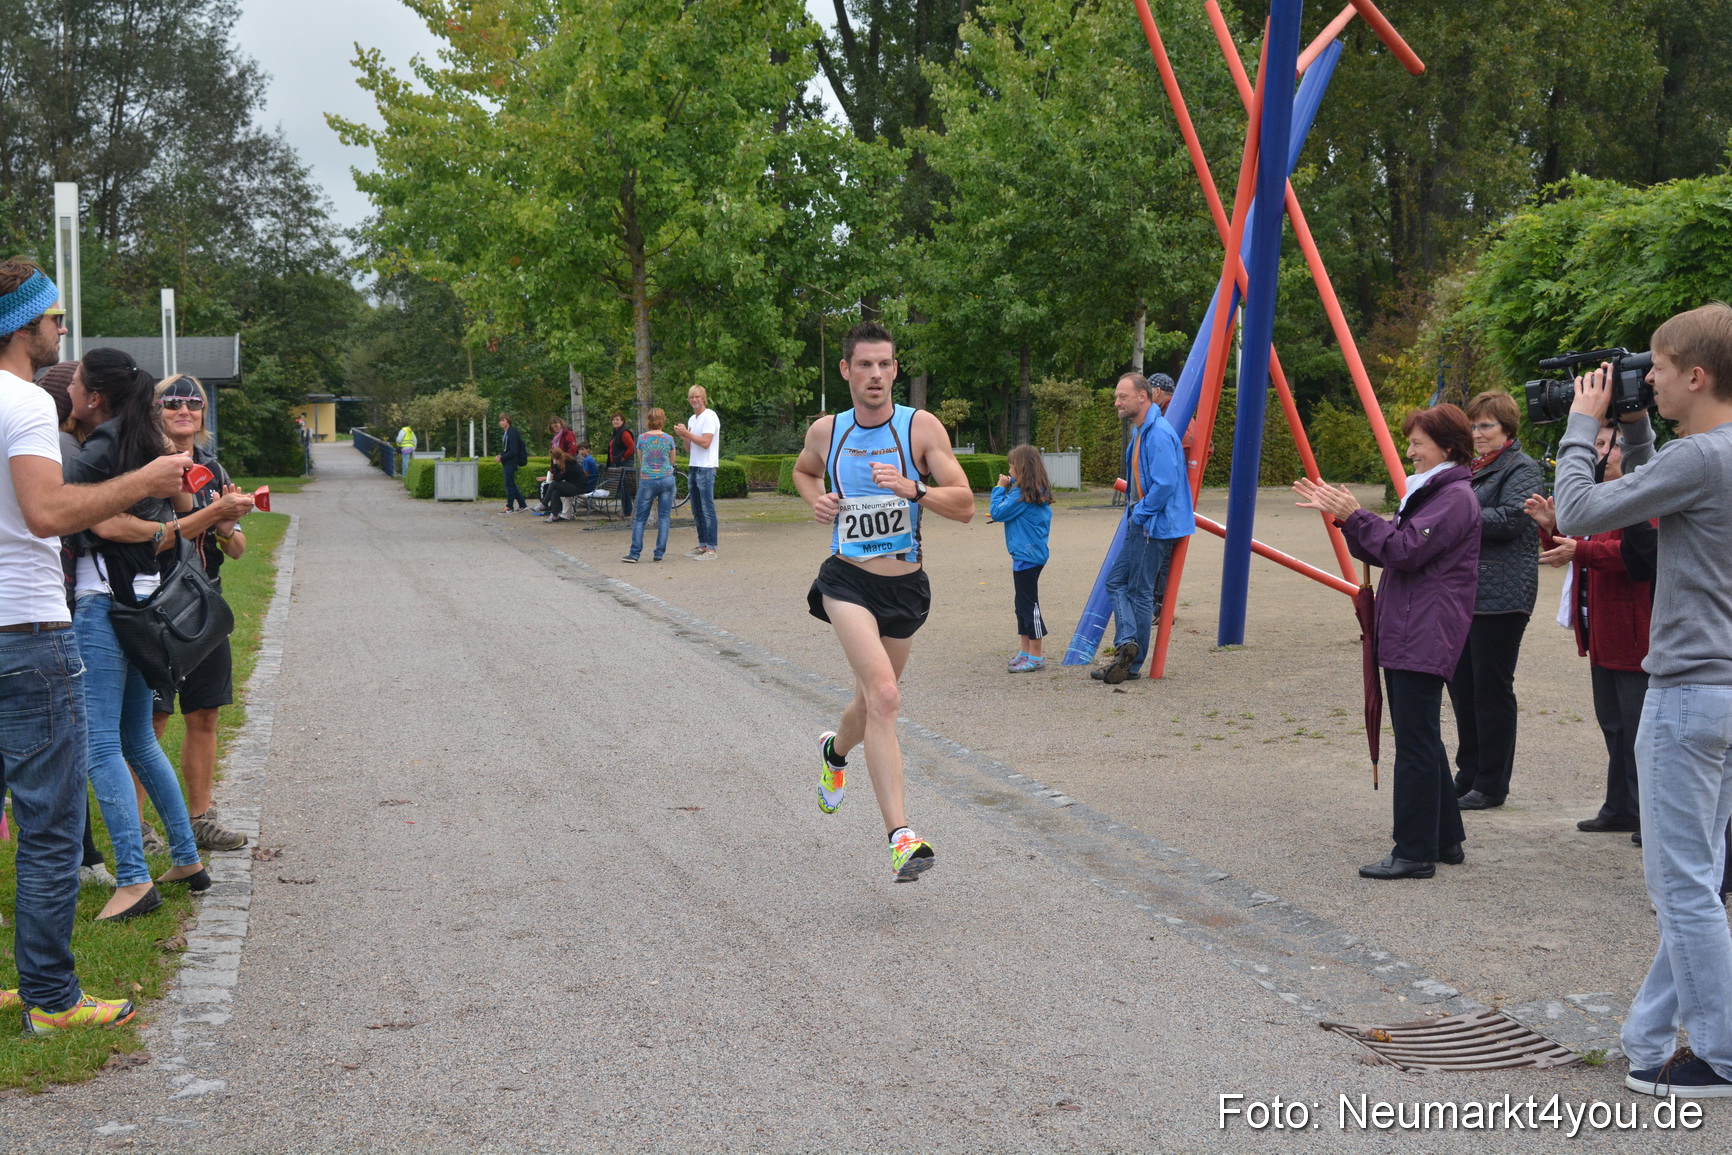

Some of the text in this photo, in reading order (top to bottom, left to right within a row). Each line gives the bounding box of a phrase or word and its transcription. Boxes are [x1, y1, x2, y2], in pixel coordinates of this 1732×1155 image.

[862, 502, 895, 510] Neumarkt
[845, 509, 905, 539] 2002
[862, 542, 893, 554] Marco
